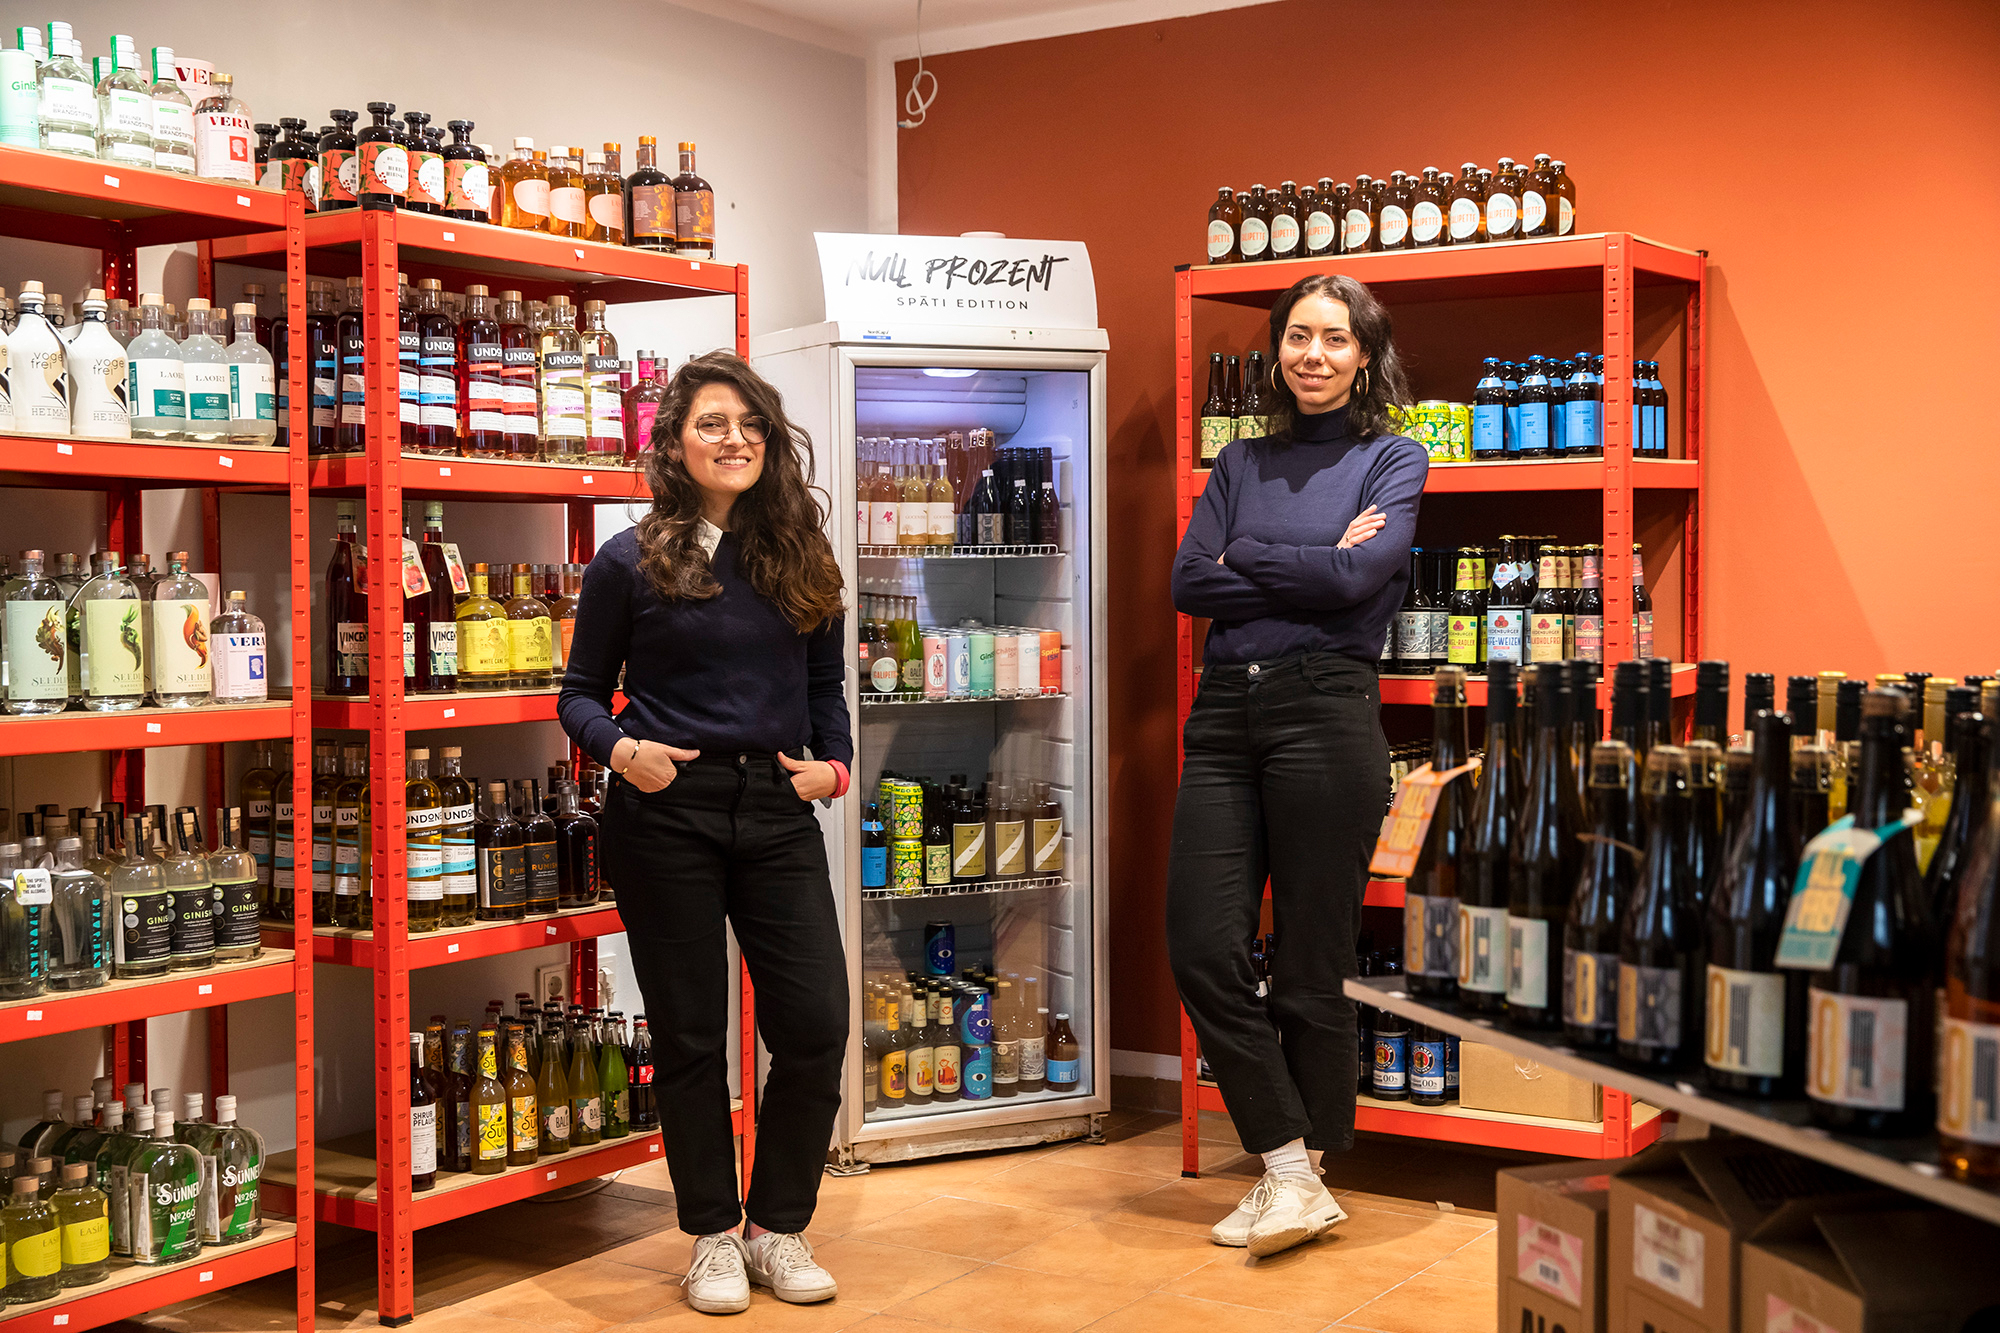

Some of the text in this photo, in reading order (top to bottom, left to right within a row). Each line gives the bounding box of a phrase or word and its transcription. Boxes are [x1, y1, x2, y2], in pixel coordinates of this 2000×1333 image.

[209, 116, 250, 130] VERA
[845, 250, 1070, 292] NULL PROZENT
[956, 298, 1029, 310] EDITION
[93, 365, 113, 375] frei
[95, 358, 125, 370] voge
